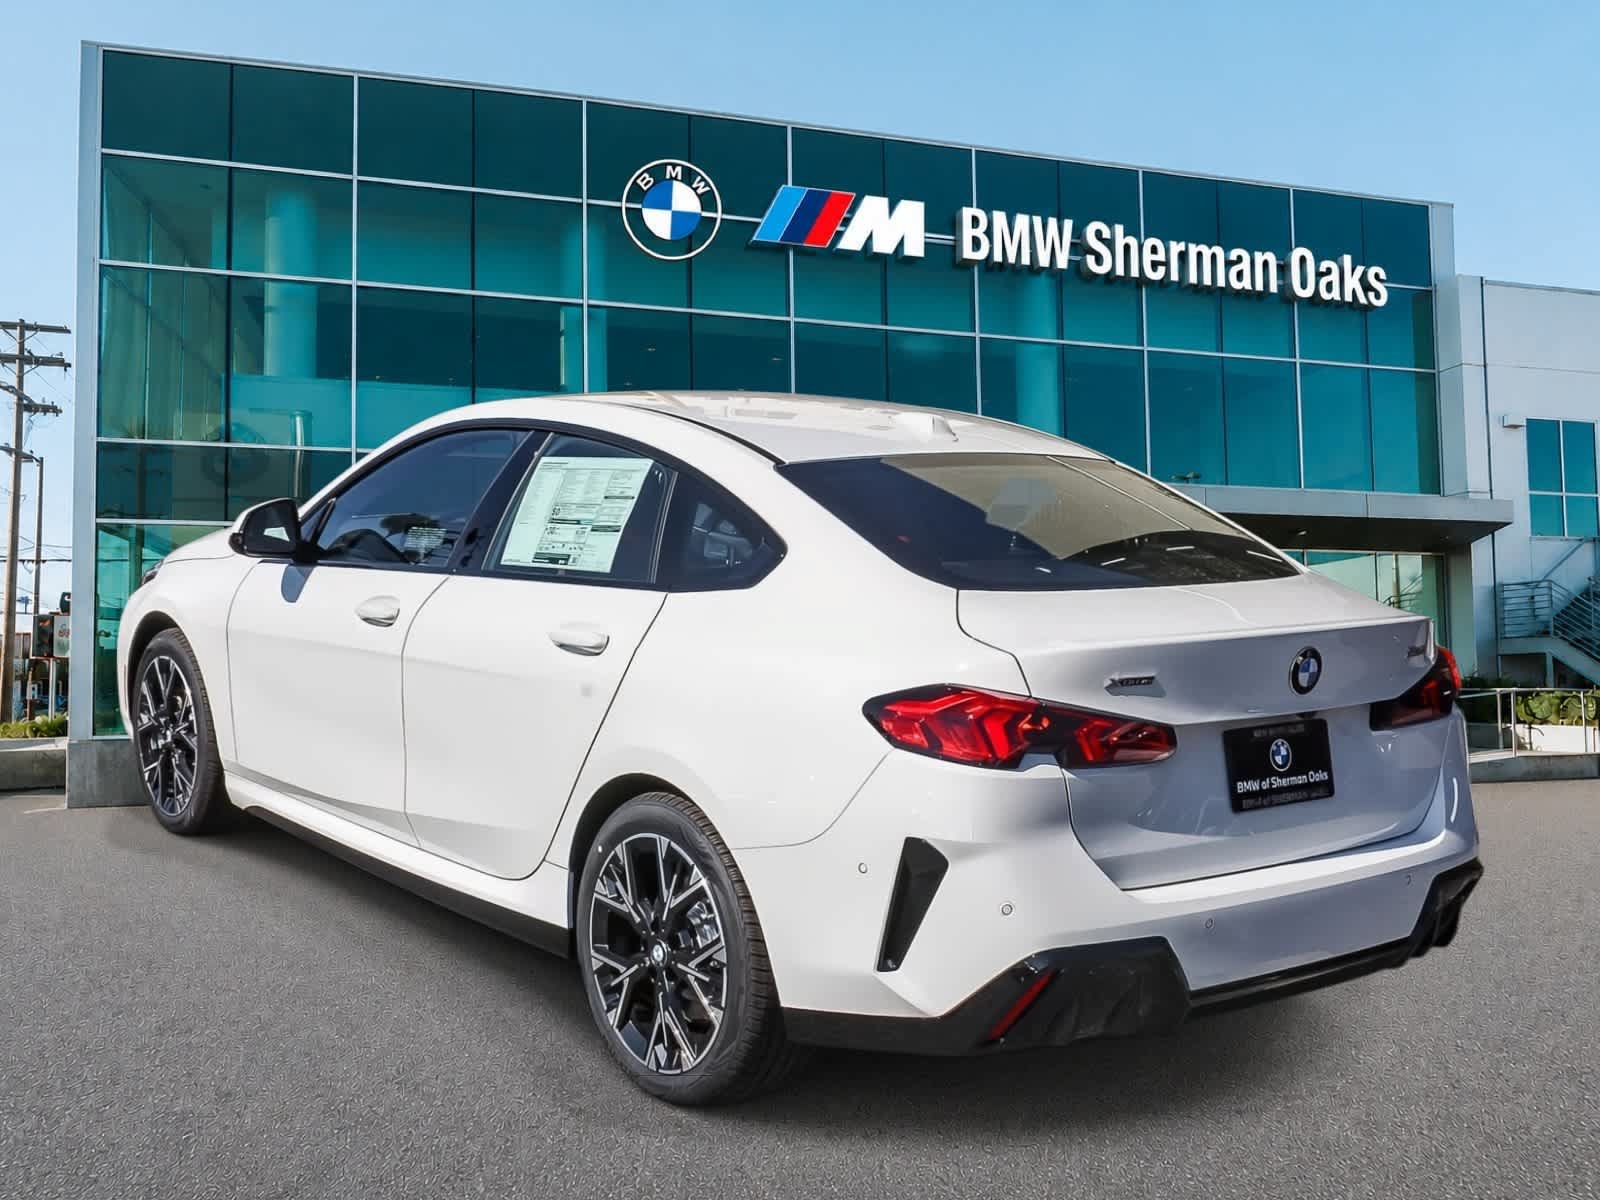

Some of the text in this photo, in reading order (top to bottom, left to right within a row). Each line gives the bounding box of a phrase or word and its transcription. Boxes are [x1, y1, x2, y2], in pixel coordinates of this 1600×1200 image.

[635, 165, 711, 195] BMW
[837, 195, 926, 257] M
[961, 206, 1388, 307] BMW Sherman Oaks
[1236, 770, 1328, 793] BMW of Sherman Oaks
